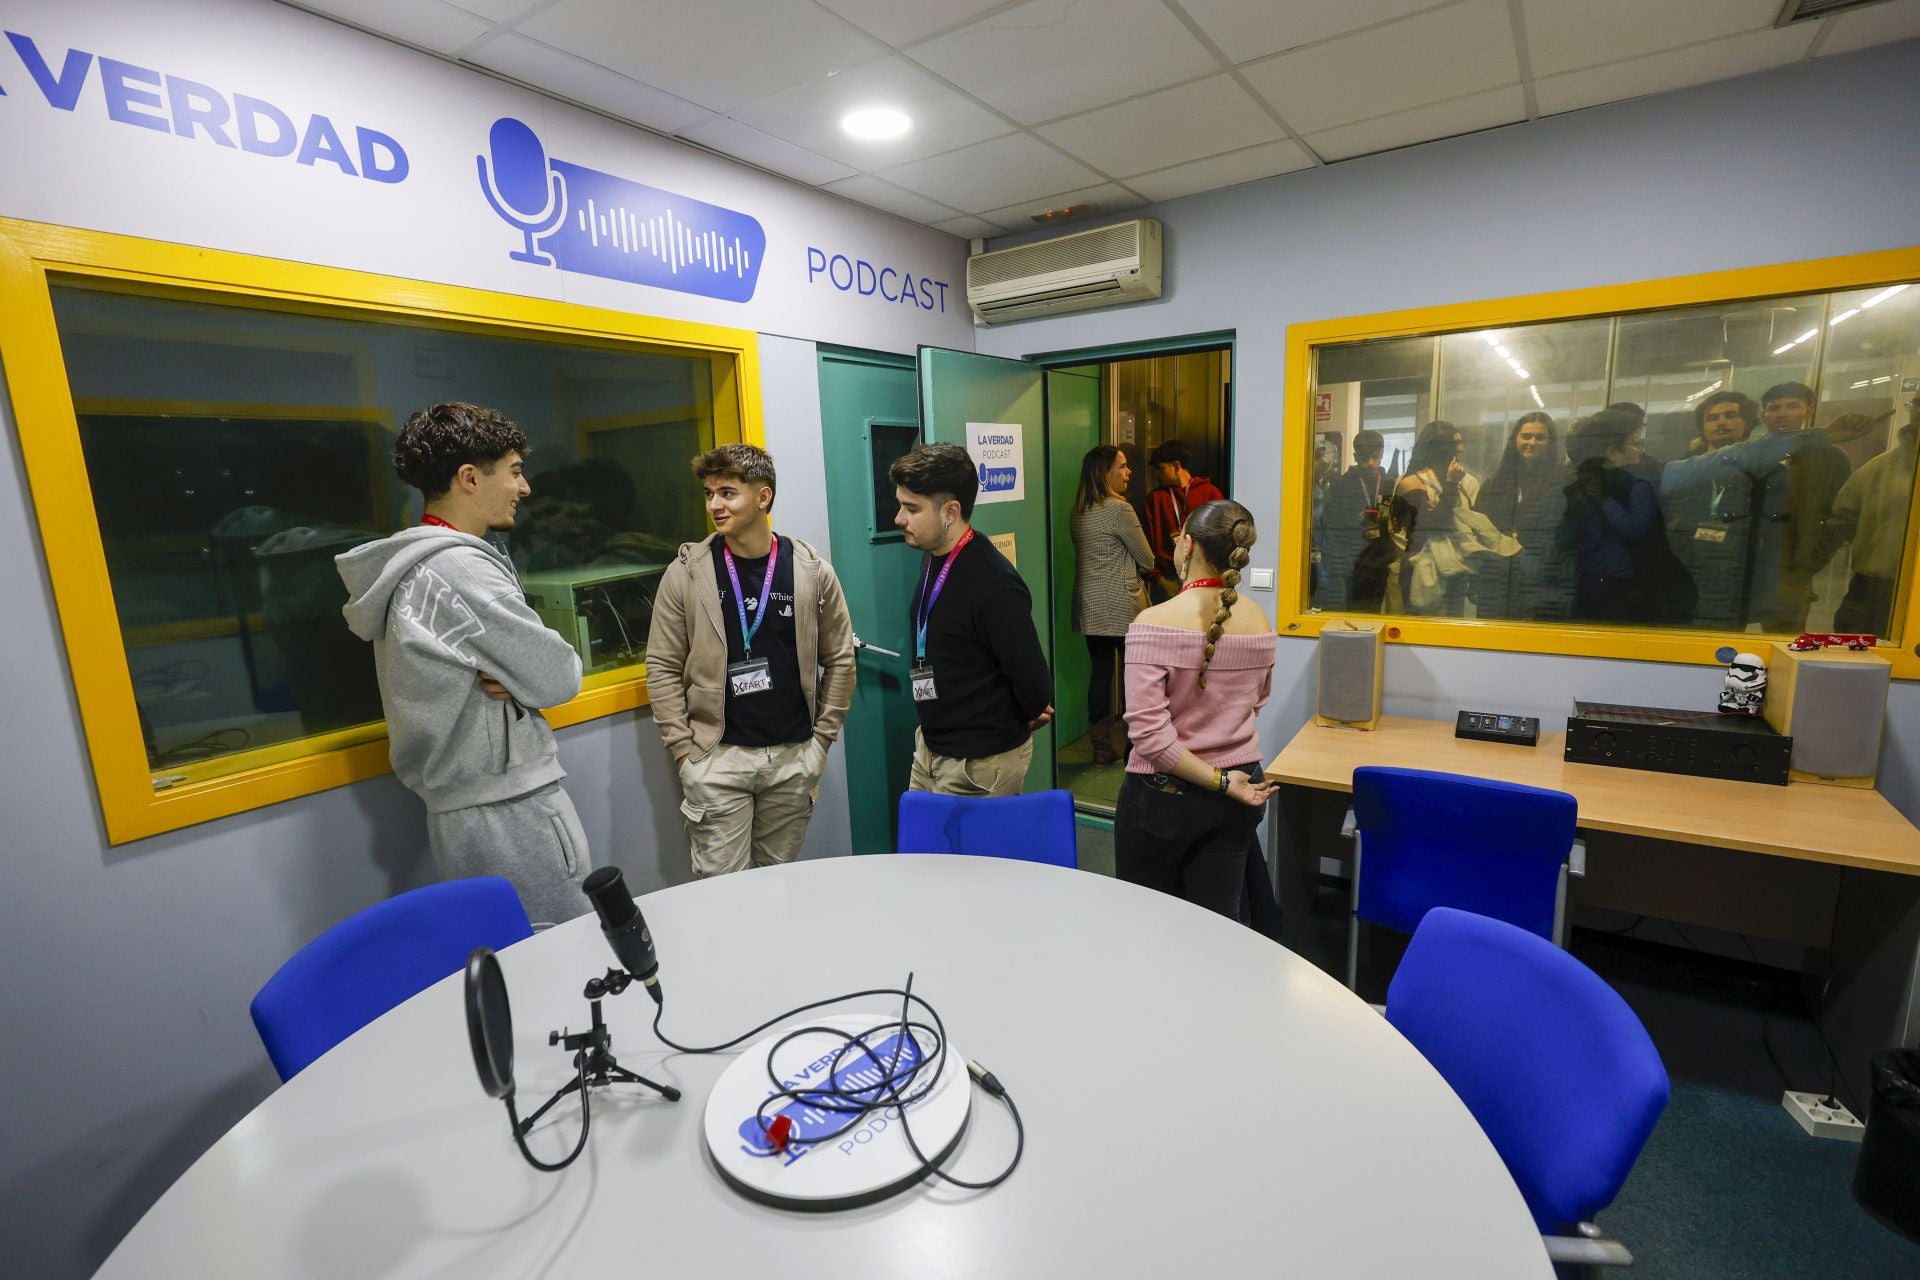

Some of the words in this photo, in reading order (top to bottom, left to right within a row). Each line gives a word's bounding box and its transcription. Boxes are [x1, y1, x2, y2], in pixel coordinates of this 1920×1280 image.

[3, 29, 410, 184] VERDAD
[806, 246, 949, 314] PODCAST
[977, 435, 988, 446] LA
[988, 435, 1014, 446] VERDAD
[982, 449, 1011, 460] PODCAST
[734, 679, 766, 693] XTART
